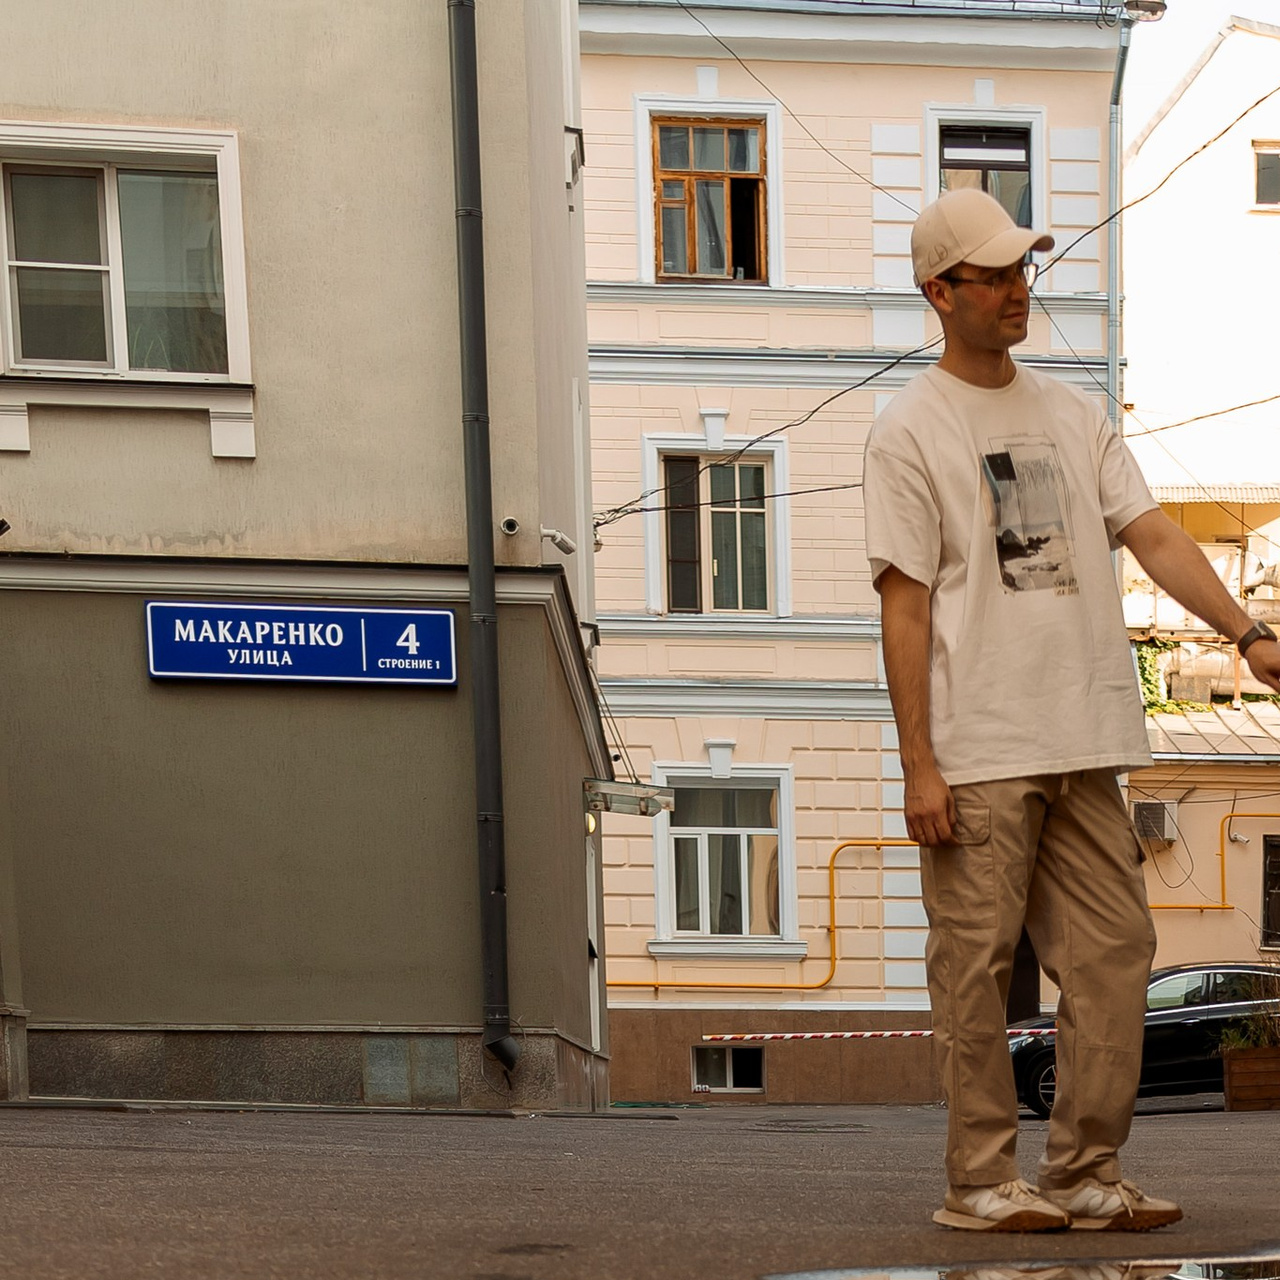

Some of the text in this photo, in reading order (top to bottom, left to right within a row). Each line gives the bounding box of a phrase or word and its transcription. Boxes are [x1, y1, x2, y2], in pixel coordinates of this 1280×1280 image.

[174, 619, 344, 647] МАКАРЕНКО
[396, 623, 420, 655] 4
[227, 649, 293, 667] УЛИЦА
[378, 658, 440, 669] СТРОЕНИЕ 1
